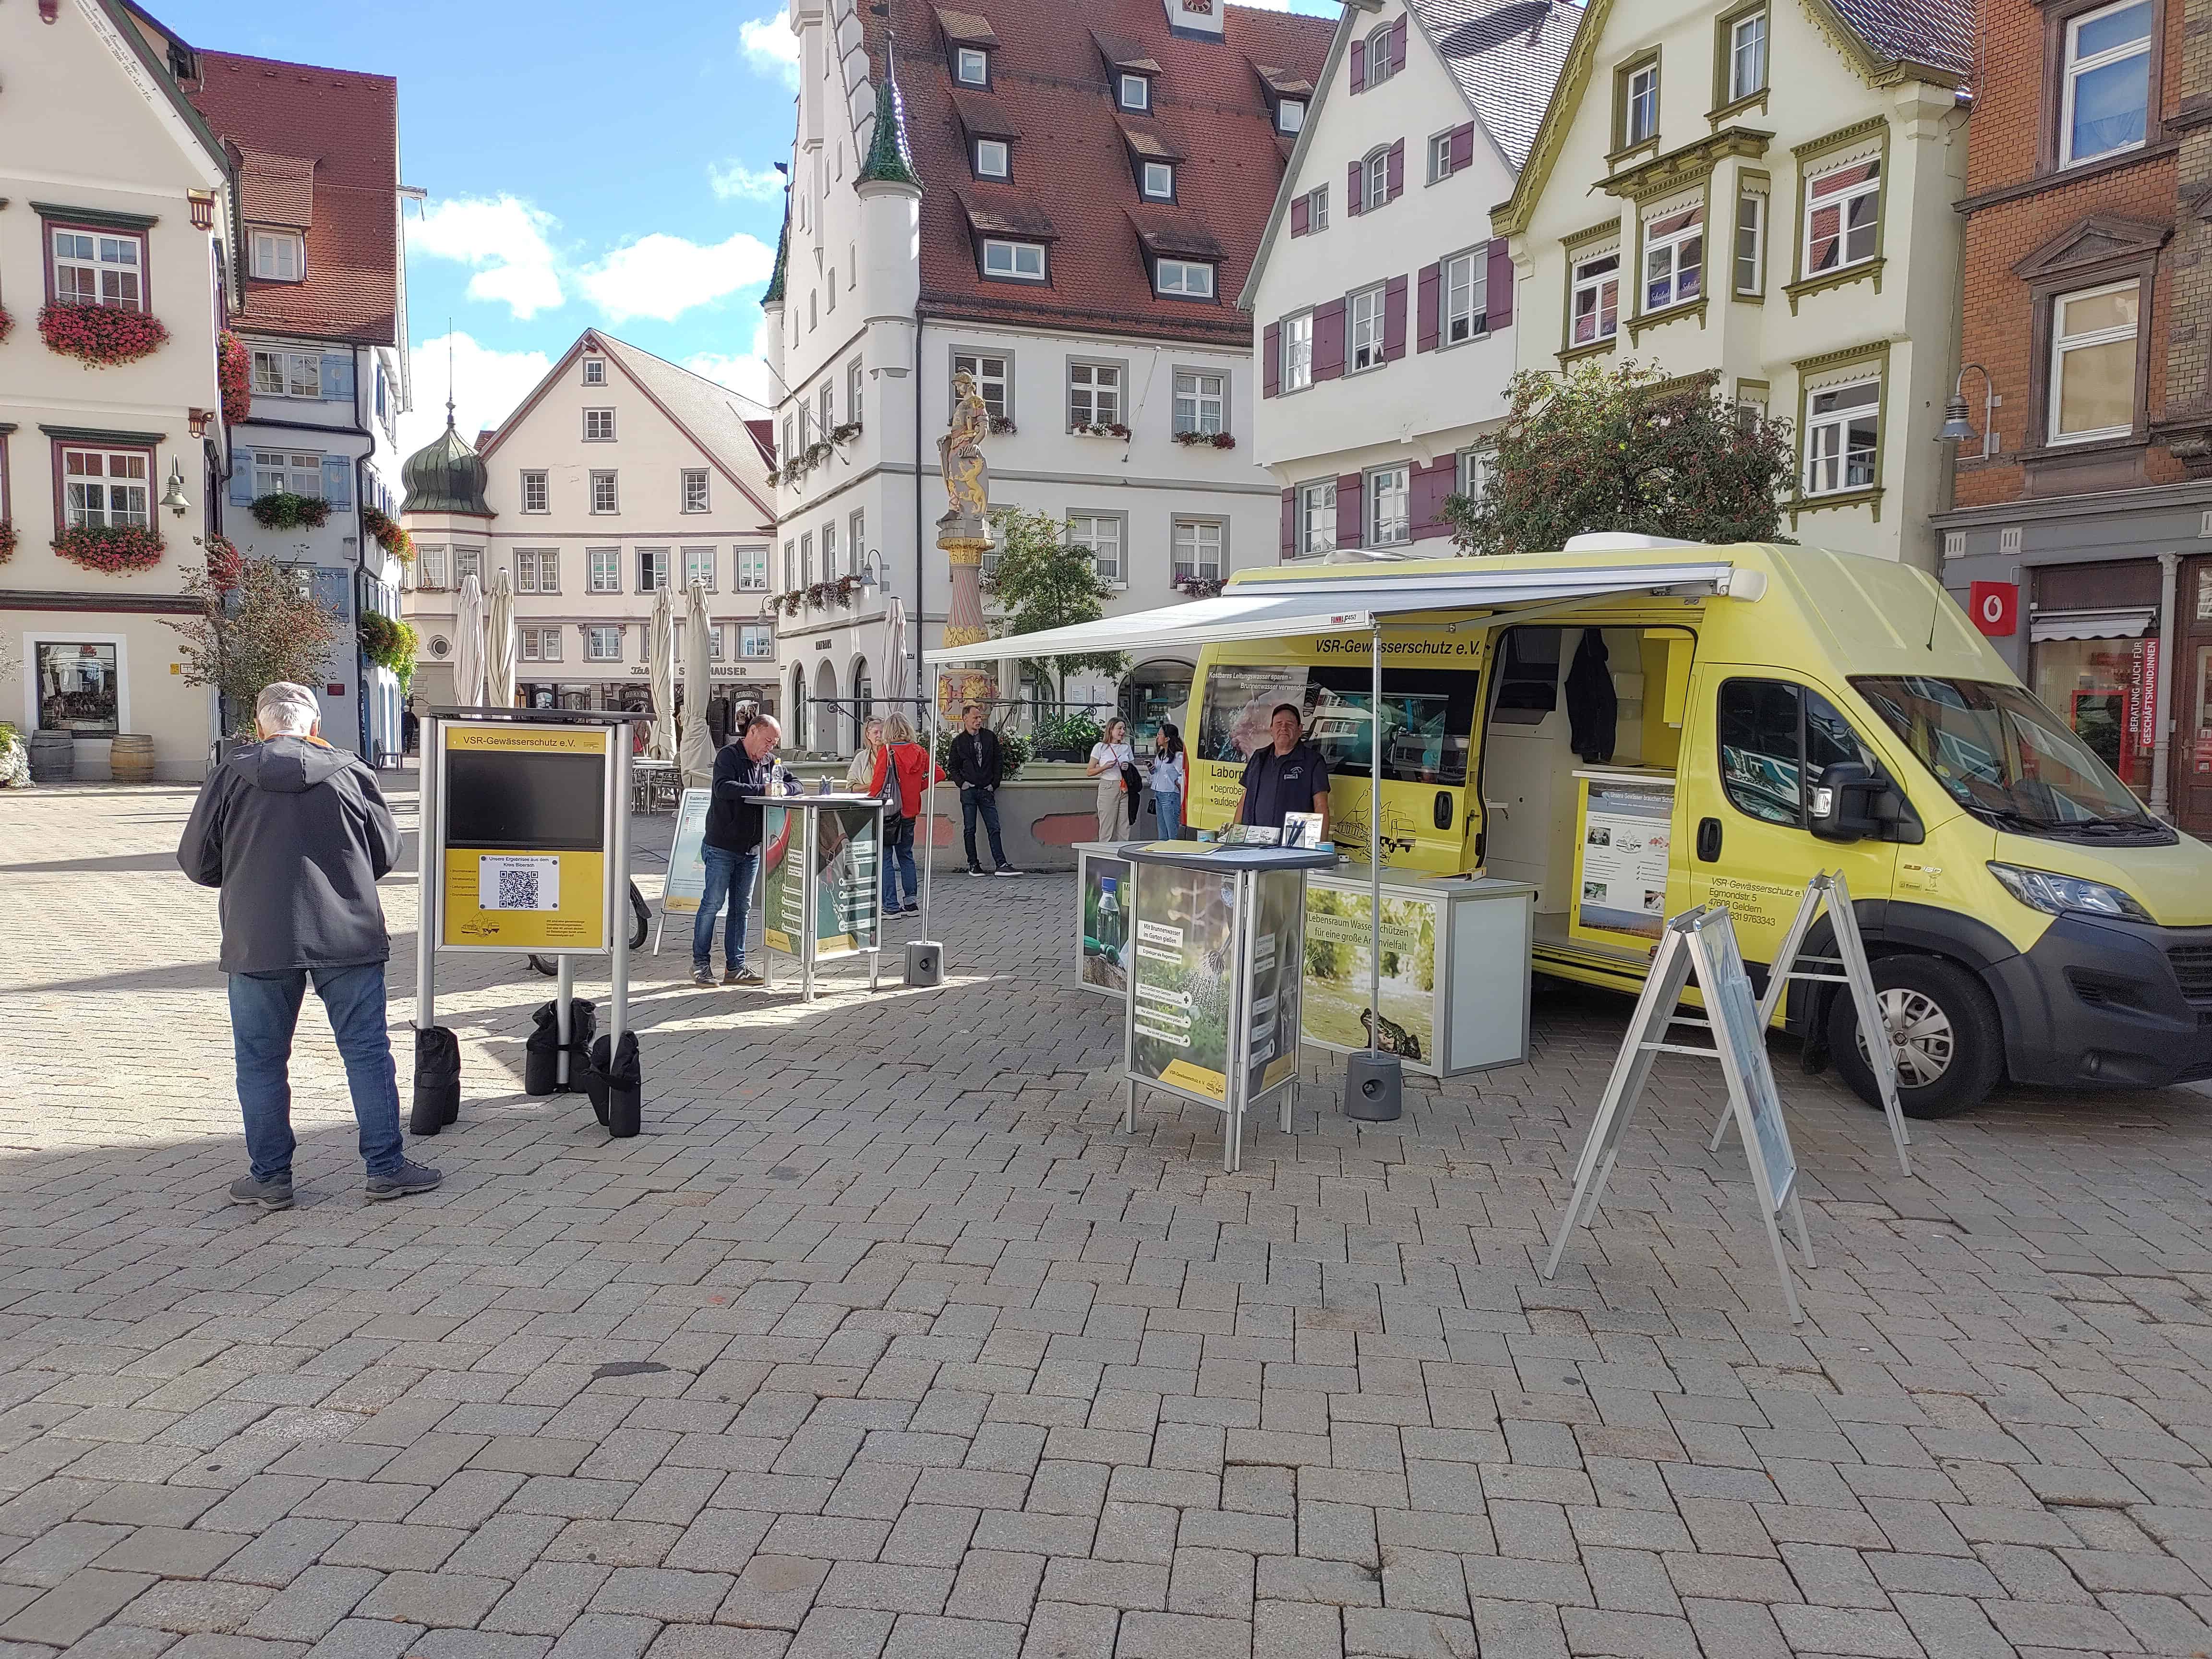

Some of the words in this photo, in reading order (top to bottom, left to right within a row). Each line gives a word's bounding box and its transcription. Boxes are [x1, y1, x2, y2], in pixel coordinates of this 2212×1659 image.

[1316, 639, 1453, 654] VSR-Gewsserschutz
[1456, 641, 1479, 655] e.V.
[2132, 641, 2142, 659] FÜR
[679, 667, 746, 676] SAUSER
[1233, 672, 1270, 680] Leitungswasser
[2133, 661, 2141, 686] AUCH
[2143, 641, 2156, 744] GESCHÄFTSKUND:INNEN
[2130, 687, 2140, 733] BERATUNG
[463, 736, 557, 746] VSR-Gewässerschutz
[1712, 877, 1793, 896] VSR-Gewässerschutz
[1709, 888, 1750, 902] Egmondstr.
[1752, 894, 1757, 902] 5
[1708, 899, 1731, 908] 47608
[1732, 902, 1762, 913] Geldern
[1308, 913, 1349, 927] Lebensraum
[1350, 919, 1372, 931] Wasse
[1380, 925, 1408, 937] chützen
[1743, 914, 1776, 926] 9763343
[1149, 933, 1162, 941] Garten
[1151, 925, 1181, 937] Brunnenwasser
[1315, 927, 1324, 937] für
[1326, 930, 1340, 939] eine
[1341, 933, 1362, 943] große
[1363, 936, 1407, 950] Arnvielfalt
